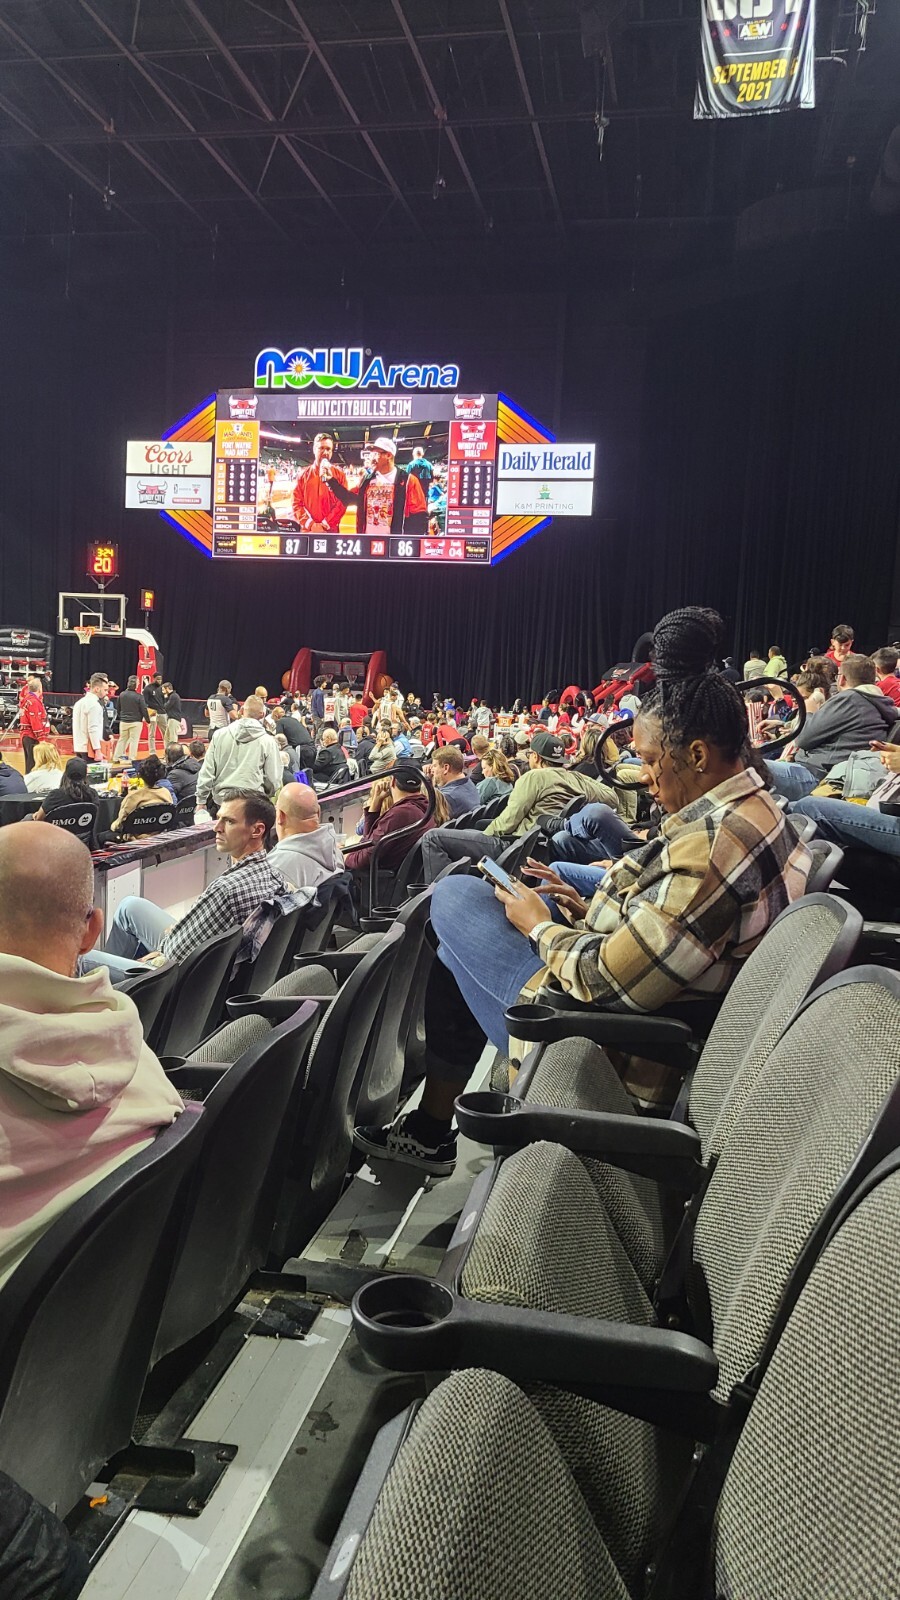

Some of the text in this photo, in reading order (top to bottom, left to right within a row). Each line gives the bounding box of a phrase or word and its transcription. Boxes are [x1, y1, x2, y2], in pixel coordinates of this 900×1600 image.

[740, 22, 772, 38] AEW
[713, 59, 788, 85] SEPTEMBER
[736, 80, 772, 103] 2021
[358, 356, 460, 388] Arena
[297, 399, 412, 417] WINDYCITYBULLS.COM
[145, 444, 193, 463] Coors
[501, 451, 592, 471] Daily Herald
[150, 464, 188, 475] LIGHT
[514, 502, 533, 510] K&M
[97, 548, 114, 557] 3:24
[285, 539, 300, 555] 87
[335, 539, 361, 556] 3:24
[372, 542, 383, 552] 20
[398, 541, 413, 556] 86
[449, 547, 462, 557] 04
[93, 557, 112, 573] 20
[210, 701, 217, 711] 40
[52, 818, 76, 826] BMO
[133, 817, 157, 825] BMO
